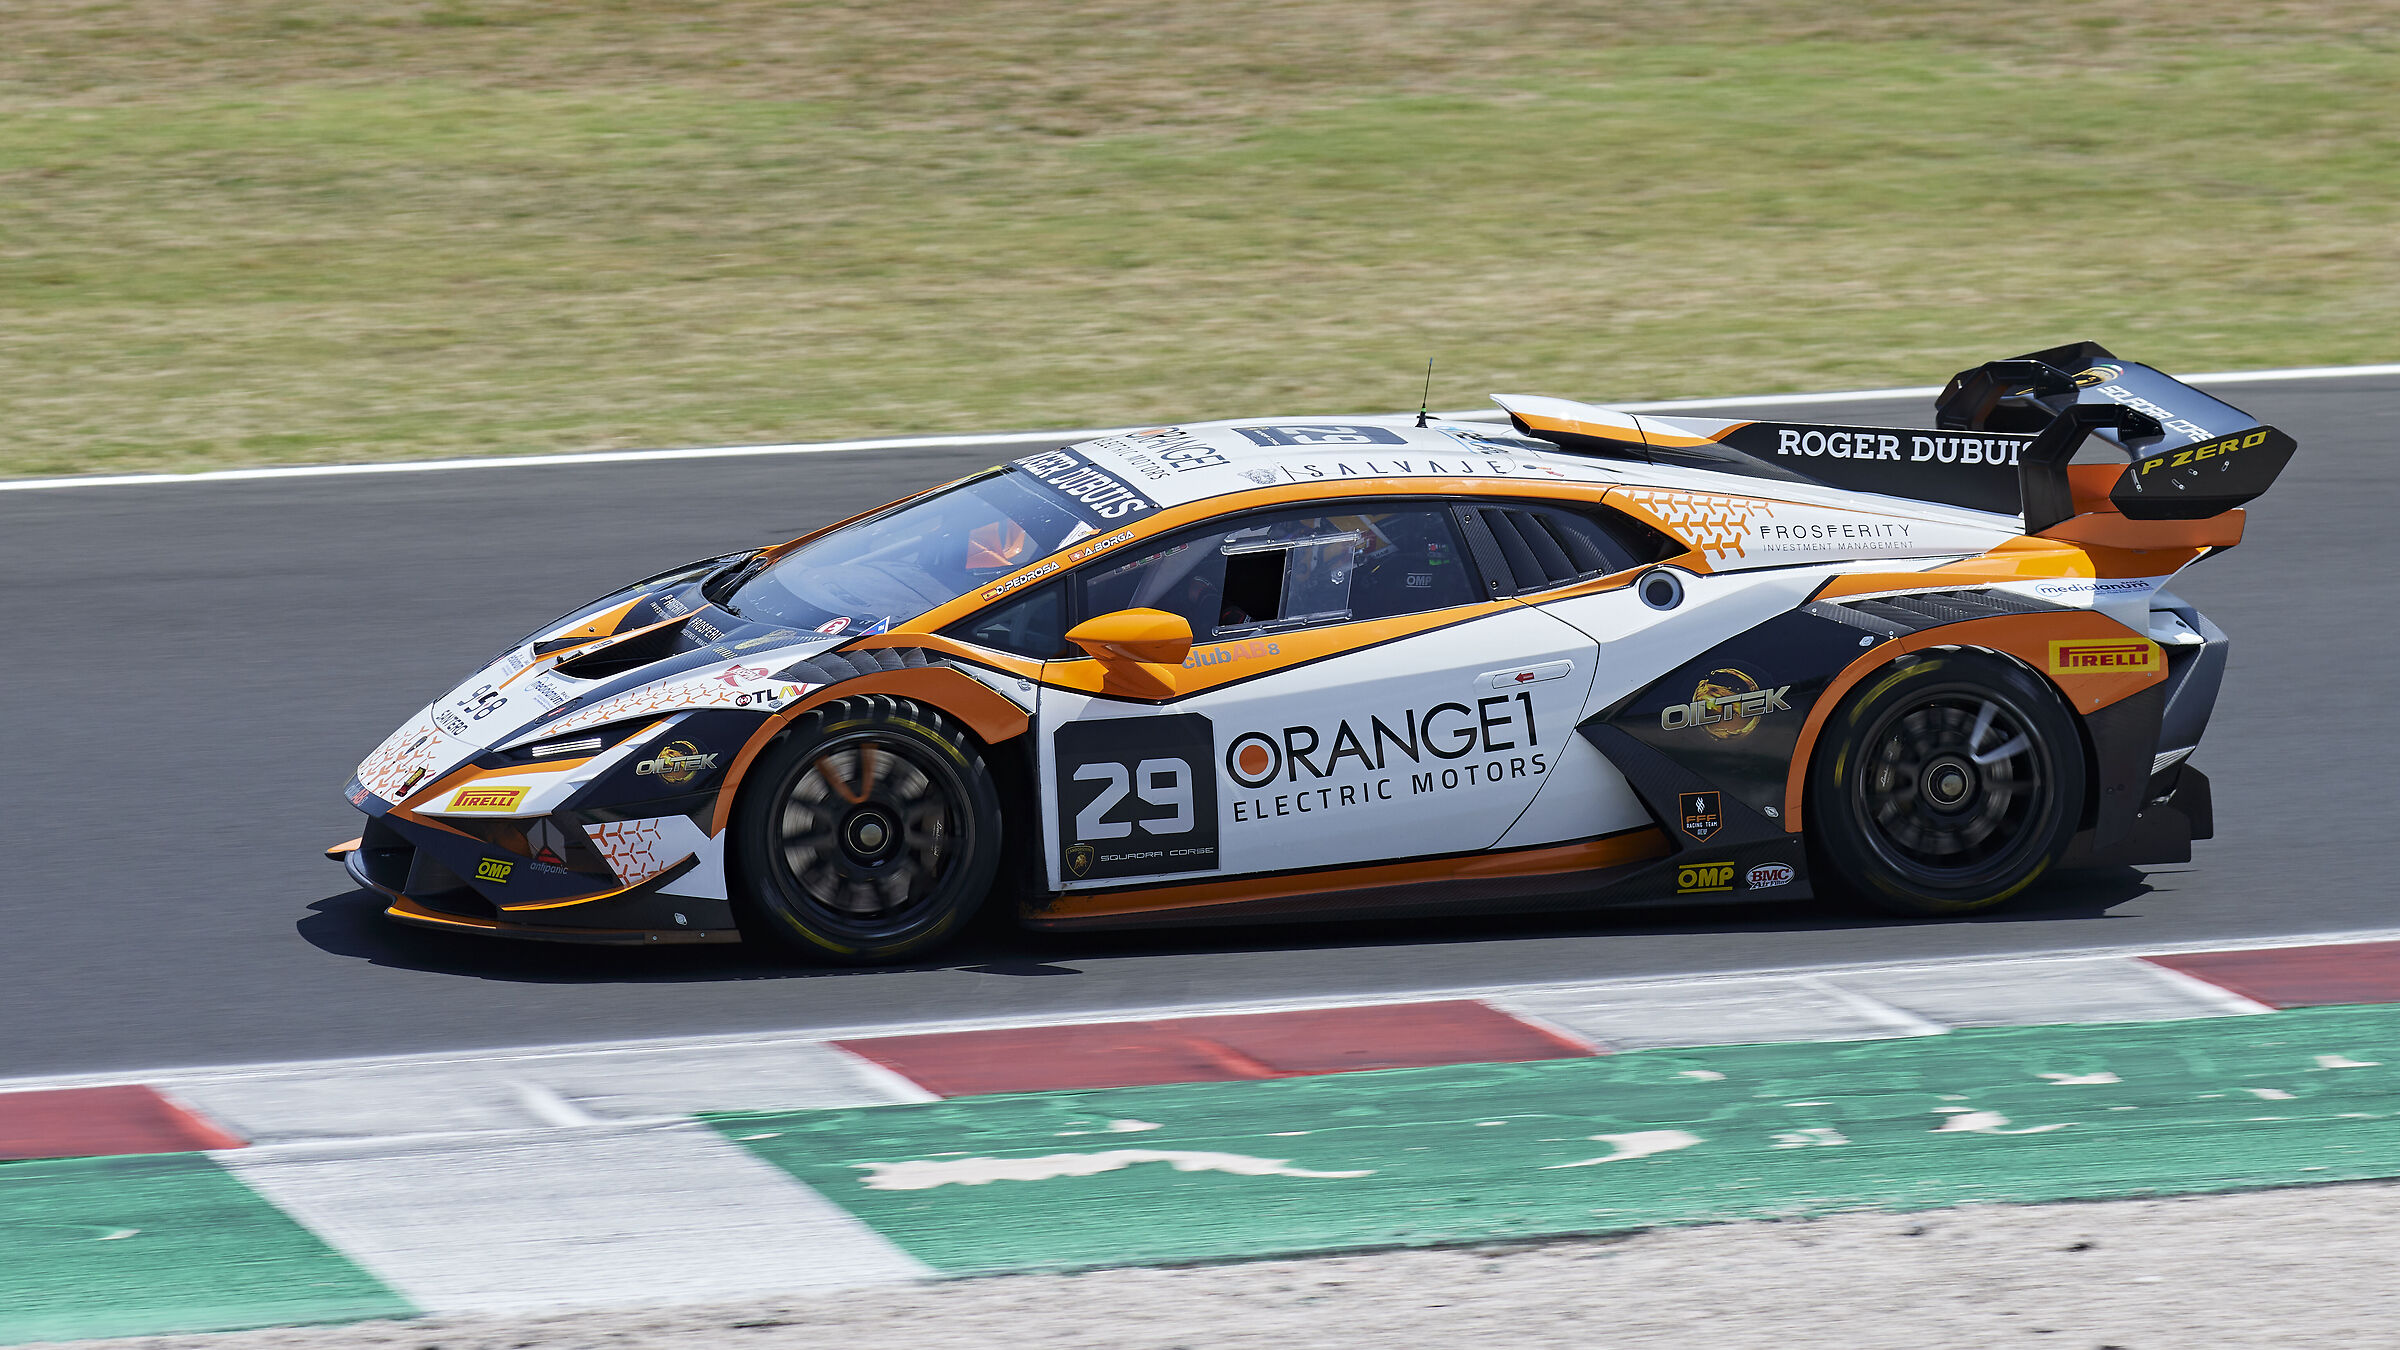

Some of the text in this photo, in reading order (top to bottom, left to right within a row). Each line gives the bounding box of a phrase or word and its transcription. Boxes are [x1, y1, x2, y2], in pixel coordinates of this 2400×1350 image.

[1777, 429, 2033, 466] ROGER DUBUI
[2141, 431, 2267, 476] P ZERO
[1047, 466, 1149, 519] DUBUIS
[1083, 530, 1135, 556] A.BORGA
[1763, 541, 1914, 552] INVESTMENT MANAGEMENT
[995, 561, 1061, 596] D.PEDROSA
[1406, 574, 1432, 587] OMP
[2040, 580, 2149, 594] mediolanum
[2059, 644, 2149, 668] PIRELLI
[1661, 685, 1792, 731] OILTEK
[1226, 690, 1538, 789] ORANGE1
[635, 753, 719, 776] OILTEK
[453, 790, 520, 807] PIRELLI
[1234, 752, 1547, 822] ELECTRIC MOTORS
[1072, 757, 1195, 841] 29
[1100, 850, 1163, 862] SQUADRA
[1169, 847, 1214, 857] CORSE
[478, 859, 512, 879] OMP
[530, 860, 569, 875] antipanic
[1678, 866, 1735, 888] OMP
[1752, 869, 1790, 882] BMC
